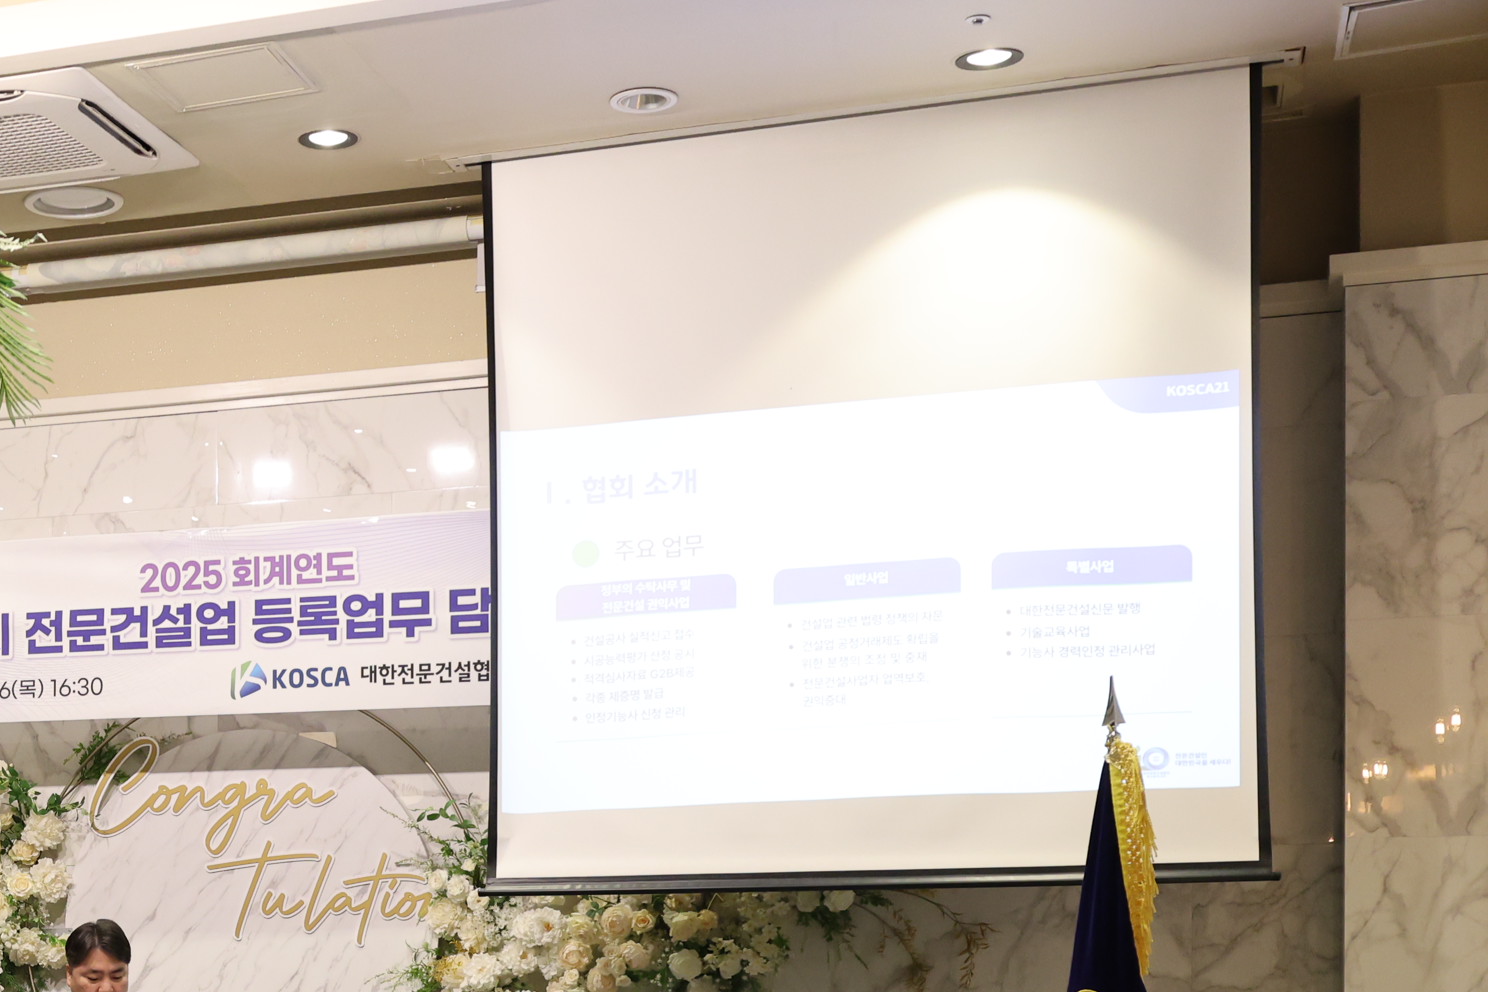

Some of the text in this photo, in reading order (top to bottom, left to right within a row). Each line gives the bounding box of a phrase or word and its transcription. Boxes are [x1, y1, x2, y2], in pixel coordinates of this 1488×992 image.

[1166, 382, 1230, 397] KOSCA21
[582, 475, 633, 504] 협회
[643, 468, 697, 496] 소개
[614, 534, 705, 562] 주요 업무
[139, 551, 356, 593] 2025 회계연도
[1065, 559, 1115, 574] 특별사업
[843, 570, 889, 587] 일반사업
[600, 582, 633, 597] 정부의
[635, 579, 679, 594] 수탁사무
[601, 598, 645, 615] 전문건설
[1019, 602, 1141, 617] 대한전문건설신문 발행
[25, 600, 236, 655] 전문건설업
[252, 590, 433, 644] 등록업무
[836, 615, 858, 628] 관련
[861, 613, 882, 626] 법령
[584, 631, 626, 647] 건설공사
[630, 629, 671, 644] 실적신고
[1020, 625, 1090, 639] 기술교육사업
[584, 651, 647, 667] 시공능력평가
[1020, 643, 1155, 659] 기능사 경력인정 관리사업
[272, 666, 351, 690] KOSCA
[360, 660, 491, 686] 대한전문건설협
[584, 666, 695, 685] 적격심사자료 G2B제공
[50, 677, 104, 698] 16:30
[585, 686, 664, 705] 각종 제증명 발급
[584, 708, 638, 724] 인정기능사
[664, 704, 686, 719] 관리
[89, 737, 337, 855] Congra
